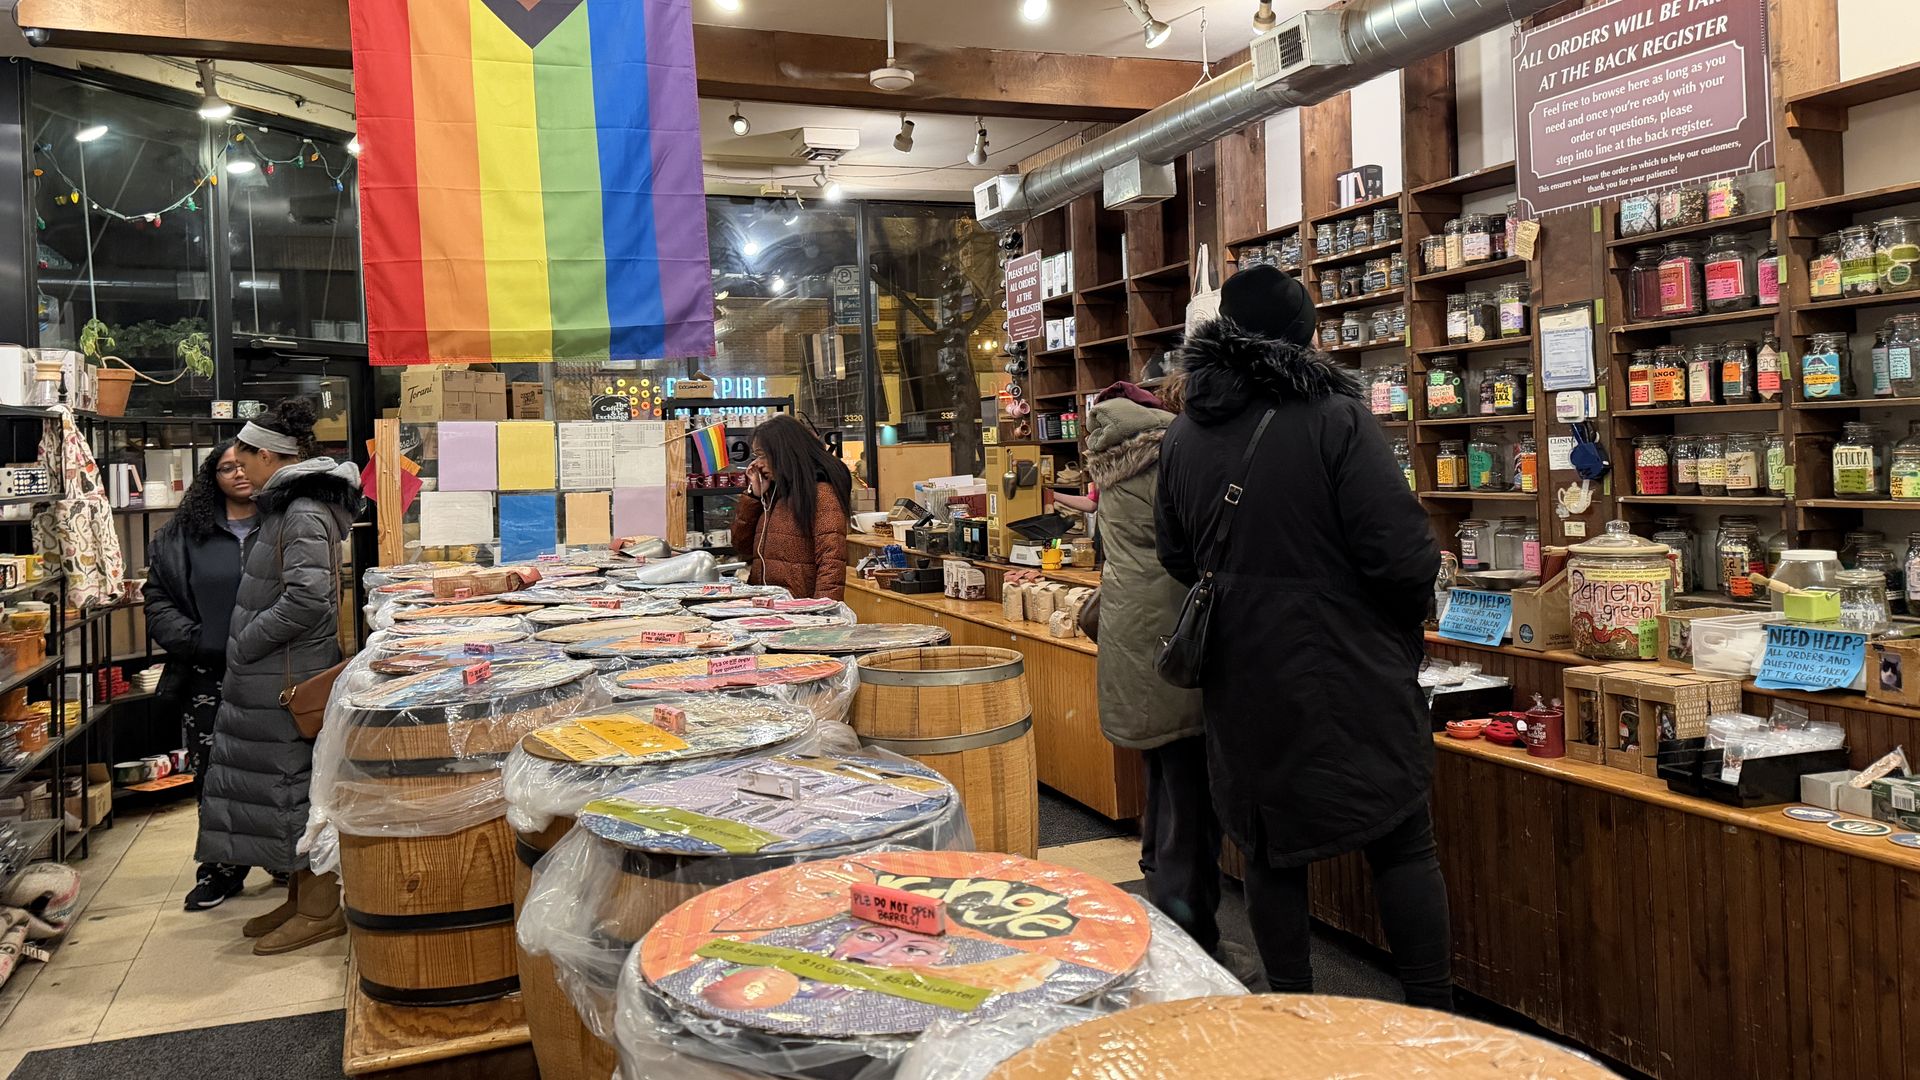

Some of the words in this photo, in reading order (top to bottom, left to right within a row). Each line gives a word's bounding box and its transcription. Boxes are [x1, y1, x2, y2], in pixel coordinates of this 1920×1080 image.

[1519, 54, 1543, 72] ALL
[1548, 28, 1609, 60] ORDERS
[1614, 15, 1654, 38] WILL
[1659, 5, 1681, 24] BE
[1538, 72, 1558, 92] AT
[1561, 65, 1590, 85] THE
[1594, 48, 1637, 74] BACK
[1642, 15, 1729, 65] REGISTER
[1543, 106, 1560, 118] Feel
[1562, 100, 1578, 114] free
[1580, 98, 1590, 109] to
[1592, 86, 1626, 104] browse
[1628, 77, 1650, 92] here
[1652, 75, 1664, 86] as
[1665, 65, 1689, 82] long
[1692, 63, 1703, 74] as
[1706, 56, 1726, 73] you
[1545, 120, 1566, 134] need
[1568, 114, 1584, 129] and
[1586, 110, 1608, 124] once
[1610, 100, 1640, 120] you're
[1642, 90, 1670, 108] ready
[1672, 81, 1696, 98] with
[1698, 74, 1725, 92] your
[1570, 130, 1594, 145] order
[1596, 128, 1607, 138] or
[1609, 114, 1658, 135] questions,
[1660, 104, 1693, 124] please
[1556, 154, 1574, 168] step
[1576, 148, 1594, 161] into
[1596, 144, 1612, 156] line
[1615, 140, 1625, 150] at
[1626, 136, 1643, 148] the
[1645, 128, 1669, 143] back
[1671, 116, 1714, 138] register.
[1538, 183, 1550, 194] This
[1550, 180, 1572, 192] ensures
[1572, 177, 1582, 185] we
[1583, 172, 1600, 184] know
[1600, 168, 1610, 178] the
[1612, 164, 1630, 176] order
[1630, 162, 1638, 171] in
[1638, 157, 1660, 170] which
[1660, 155, 1668, 164] to
[1669, 152, 1686, 164] help
[1686, 150, 1700, 158] our
[1700, 140, 1742, 156] customers,
[1587, 183, 1605, 194] thank
[1606, 182, 1618, 192] you
[1618, 177, 1628, 186] for
[1629, 176, 1646, 188] your
[1646, 166, 1678, 182] patience!
[1008, 266, 1024, 280] PLEASE
[1024, 262, 1038, 275] PLACE
[1010, 282, 1018, 292] ALL
[1018, 276, 1036, 290] ORDERS
[1016, 293, 1022, 304] AT
[1023, 290, 1032, 301] THE
[1020, 302, 1042, 315] REGISTER
[408, 383, 432, 403] Torani
[595, 414, 628, 422] Exchange
[844, 414, 864, 422] 3320
[941, 412, 958, 420] 332
[1451, 590, 1478, 606] NEED
[1479, 594, 1511, 612] HELP?
[1446, 614, 1478, 624] QUESTIONS
[1480, 618, 1500, 628] TAKEN
[1462, 608, 1486, 616] ORDERS
[1488, 612, 1502, 620] AND
[1600, 604, 1653, 621] green
[1768, 628, 1810, 648] NEED
[1812, 632, 1864, 656] HELP?
[1767, 648, 1783, 656] ALL
[1786, 650, 1824, 662] ORDERS
[1826, 655, 1851, 666] AND
[1760, 668, 1772, 678] AT
[1776, 670, 1792, 680] THE
[1763, 658, 1814, 672] QUESTIONS
[1819, 665, 1850, 676] TAKEN
[854, 893, 871, 908] PLE
[874, 896, 888, 908] DO
[890, 899, 908, 912] NOT
[911, 903, 936, 920] OPEN
[877, 910, 920, 928] BARRELS!
[881, 973, 923, 989] $5.00
